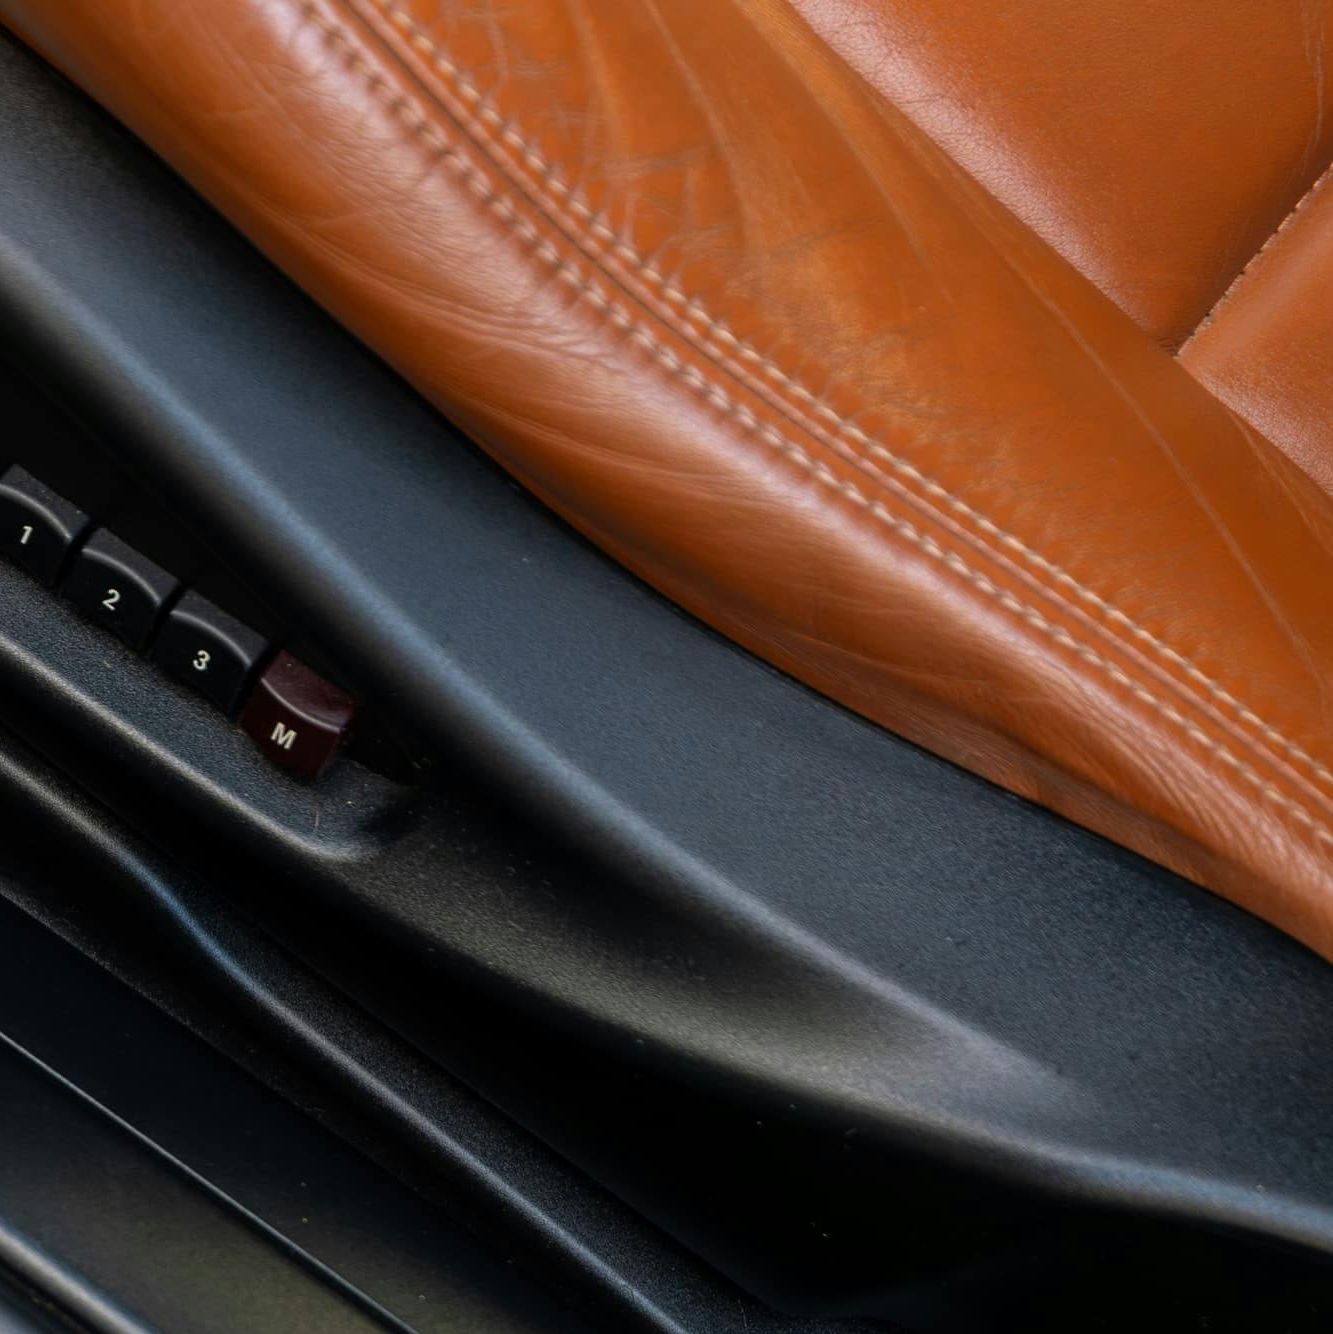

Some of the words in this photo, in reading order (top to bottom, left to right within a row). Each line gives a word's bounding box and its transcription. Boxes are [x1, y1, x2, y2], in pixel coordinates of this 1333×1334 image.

[20, 525, 33, 545] 1
[101, 588, 121, 611] 2
[192, 650, 211, 671] 3
[270, 722, 298, 750] M
